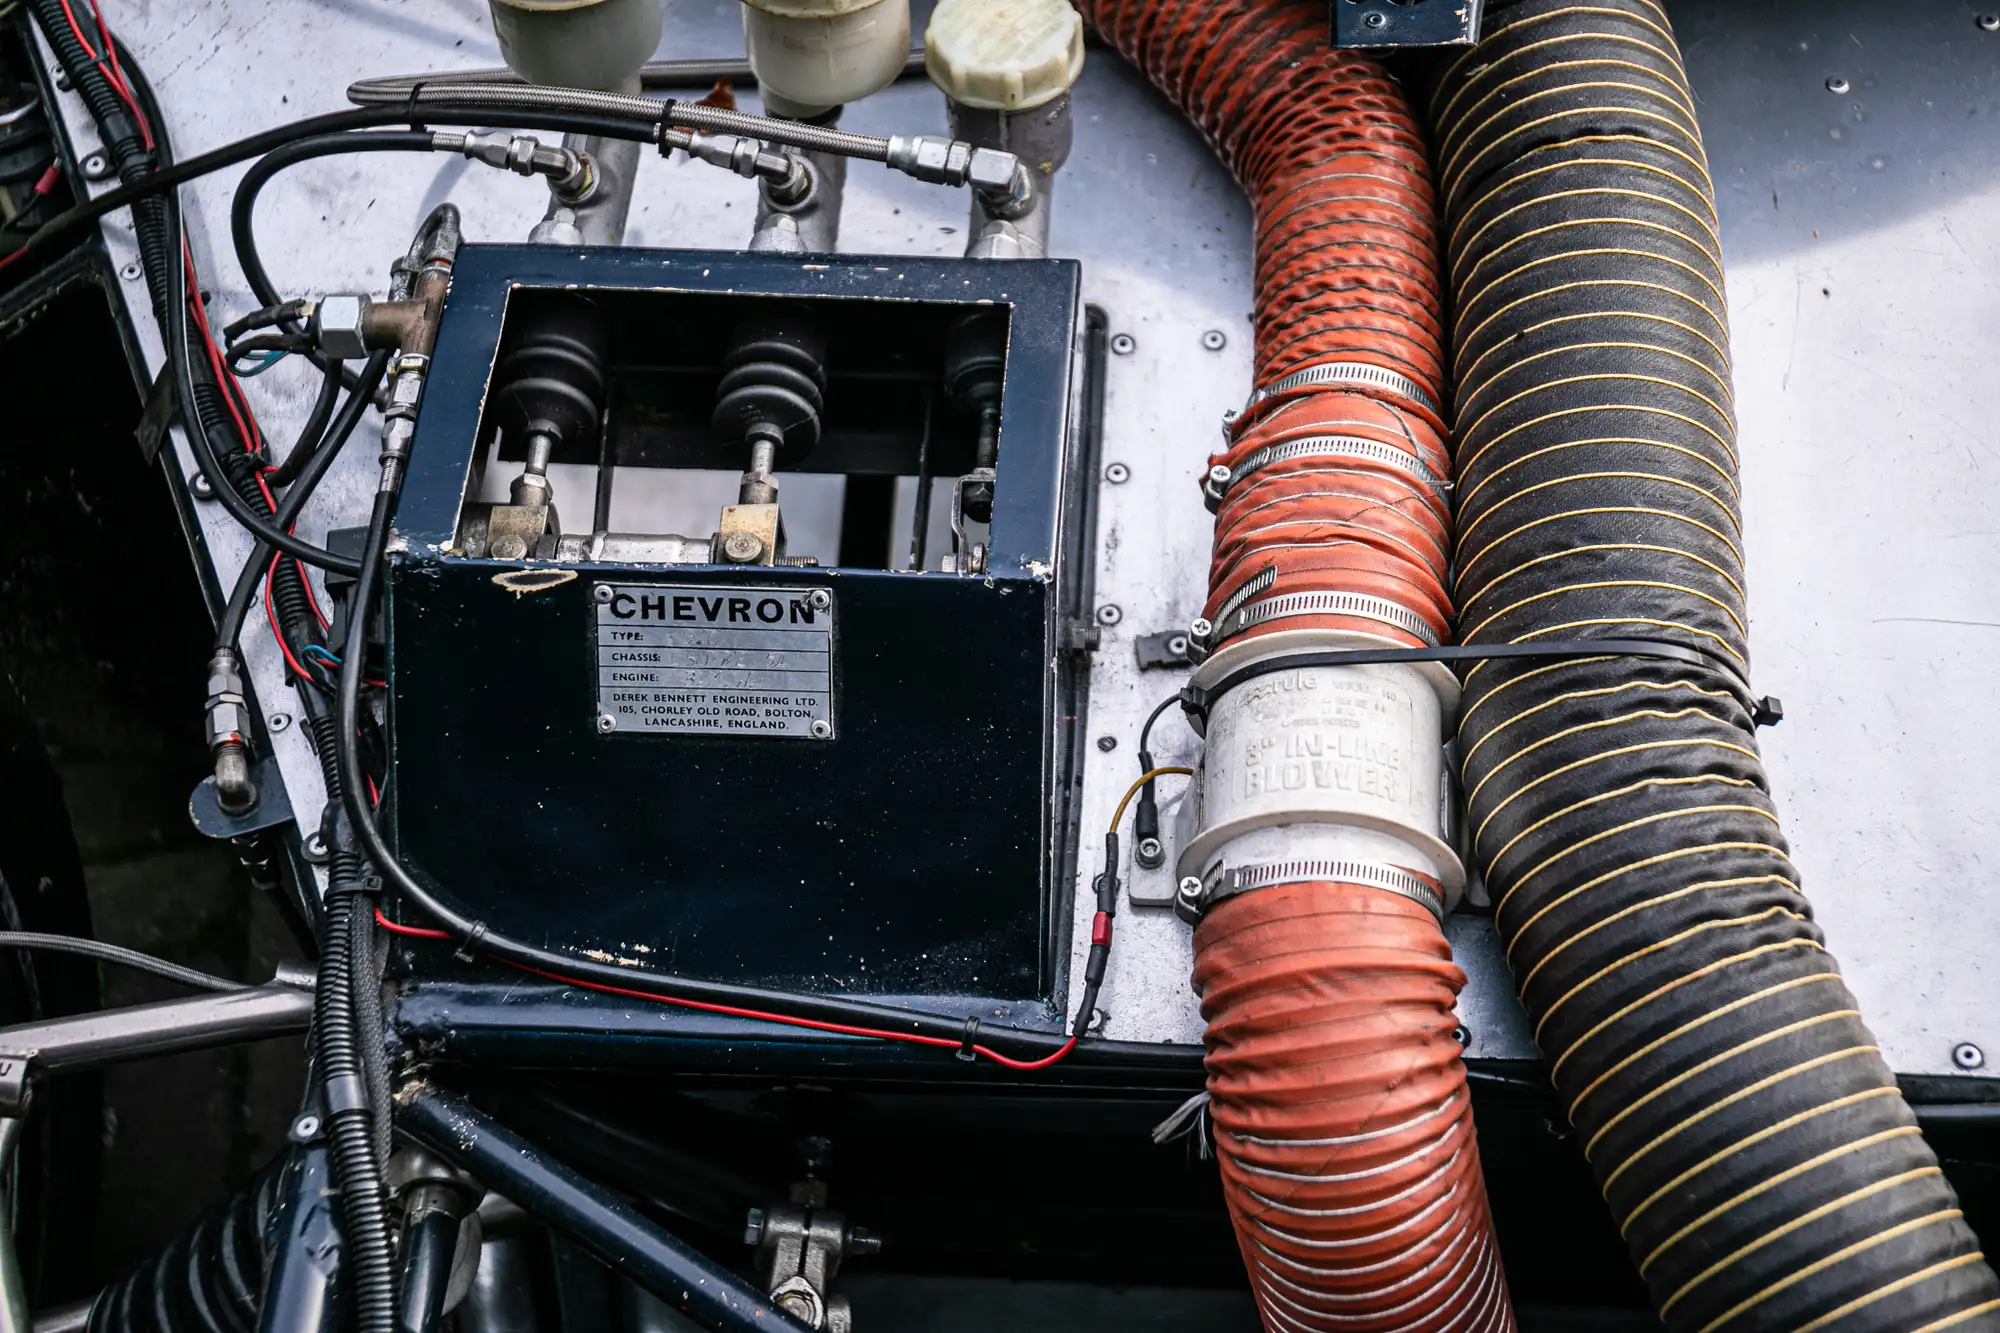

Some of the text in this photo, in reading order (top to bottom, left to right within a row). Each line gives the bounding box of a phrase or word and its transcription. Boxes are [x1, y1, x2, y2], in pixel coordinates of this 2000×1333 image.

[610, 593, 815, 624] CHEVRON
[611, 631, 644, 641] TYPE:
[612, 652, 661, 662] CHASSIS:
[612, 673, 659, 682] ENGINE:
[613, 693, 819, 707] DEREK BENNETT ENGINEERING LTD.
[618, 705, 815, 719] 105, CHORLEY OLD ROAD, BOLTON,
[644, 717, 790, 730] LANCASHIRE, ENGLAND.
[1285, 733, 1400, 772] IN-LINE
[1244, 760, 1398, 803] BLOWER
